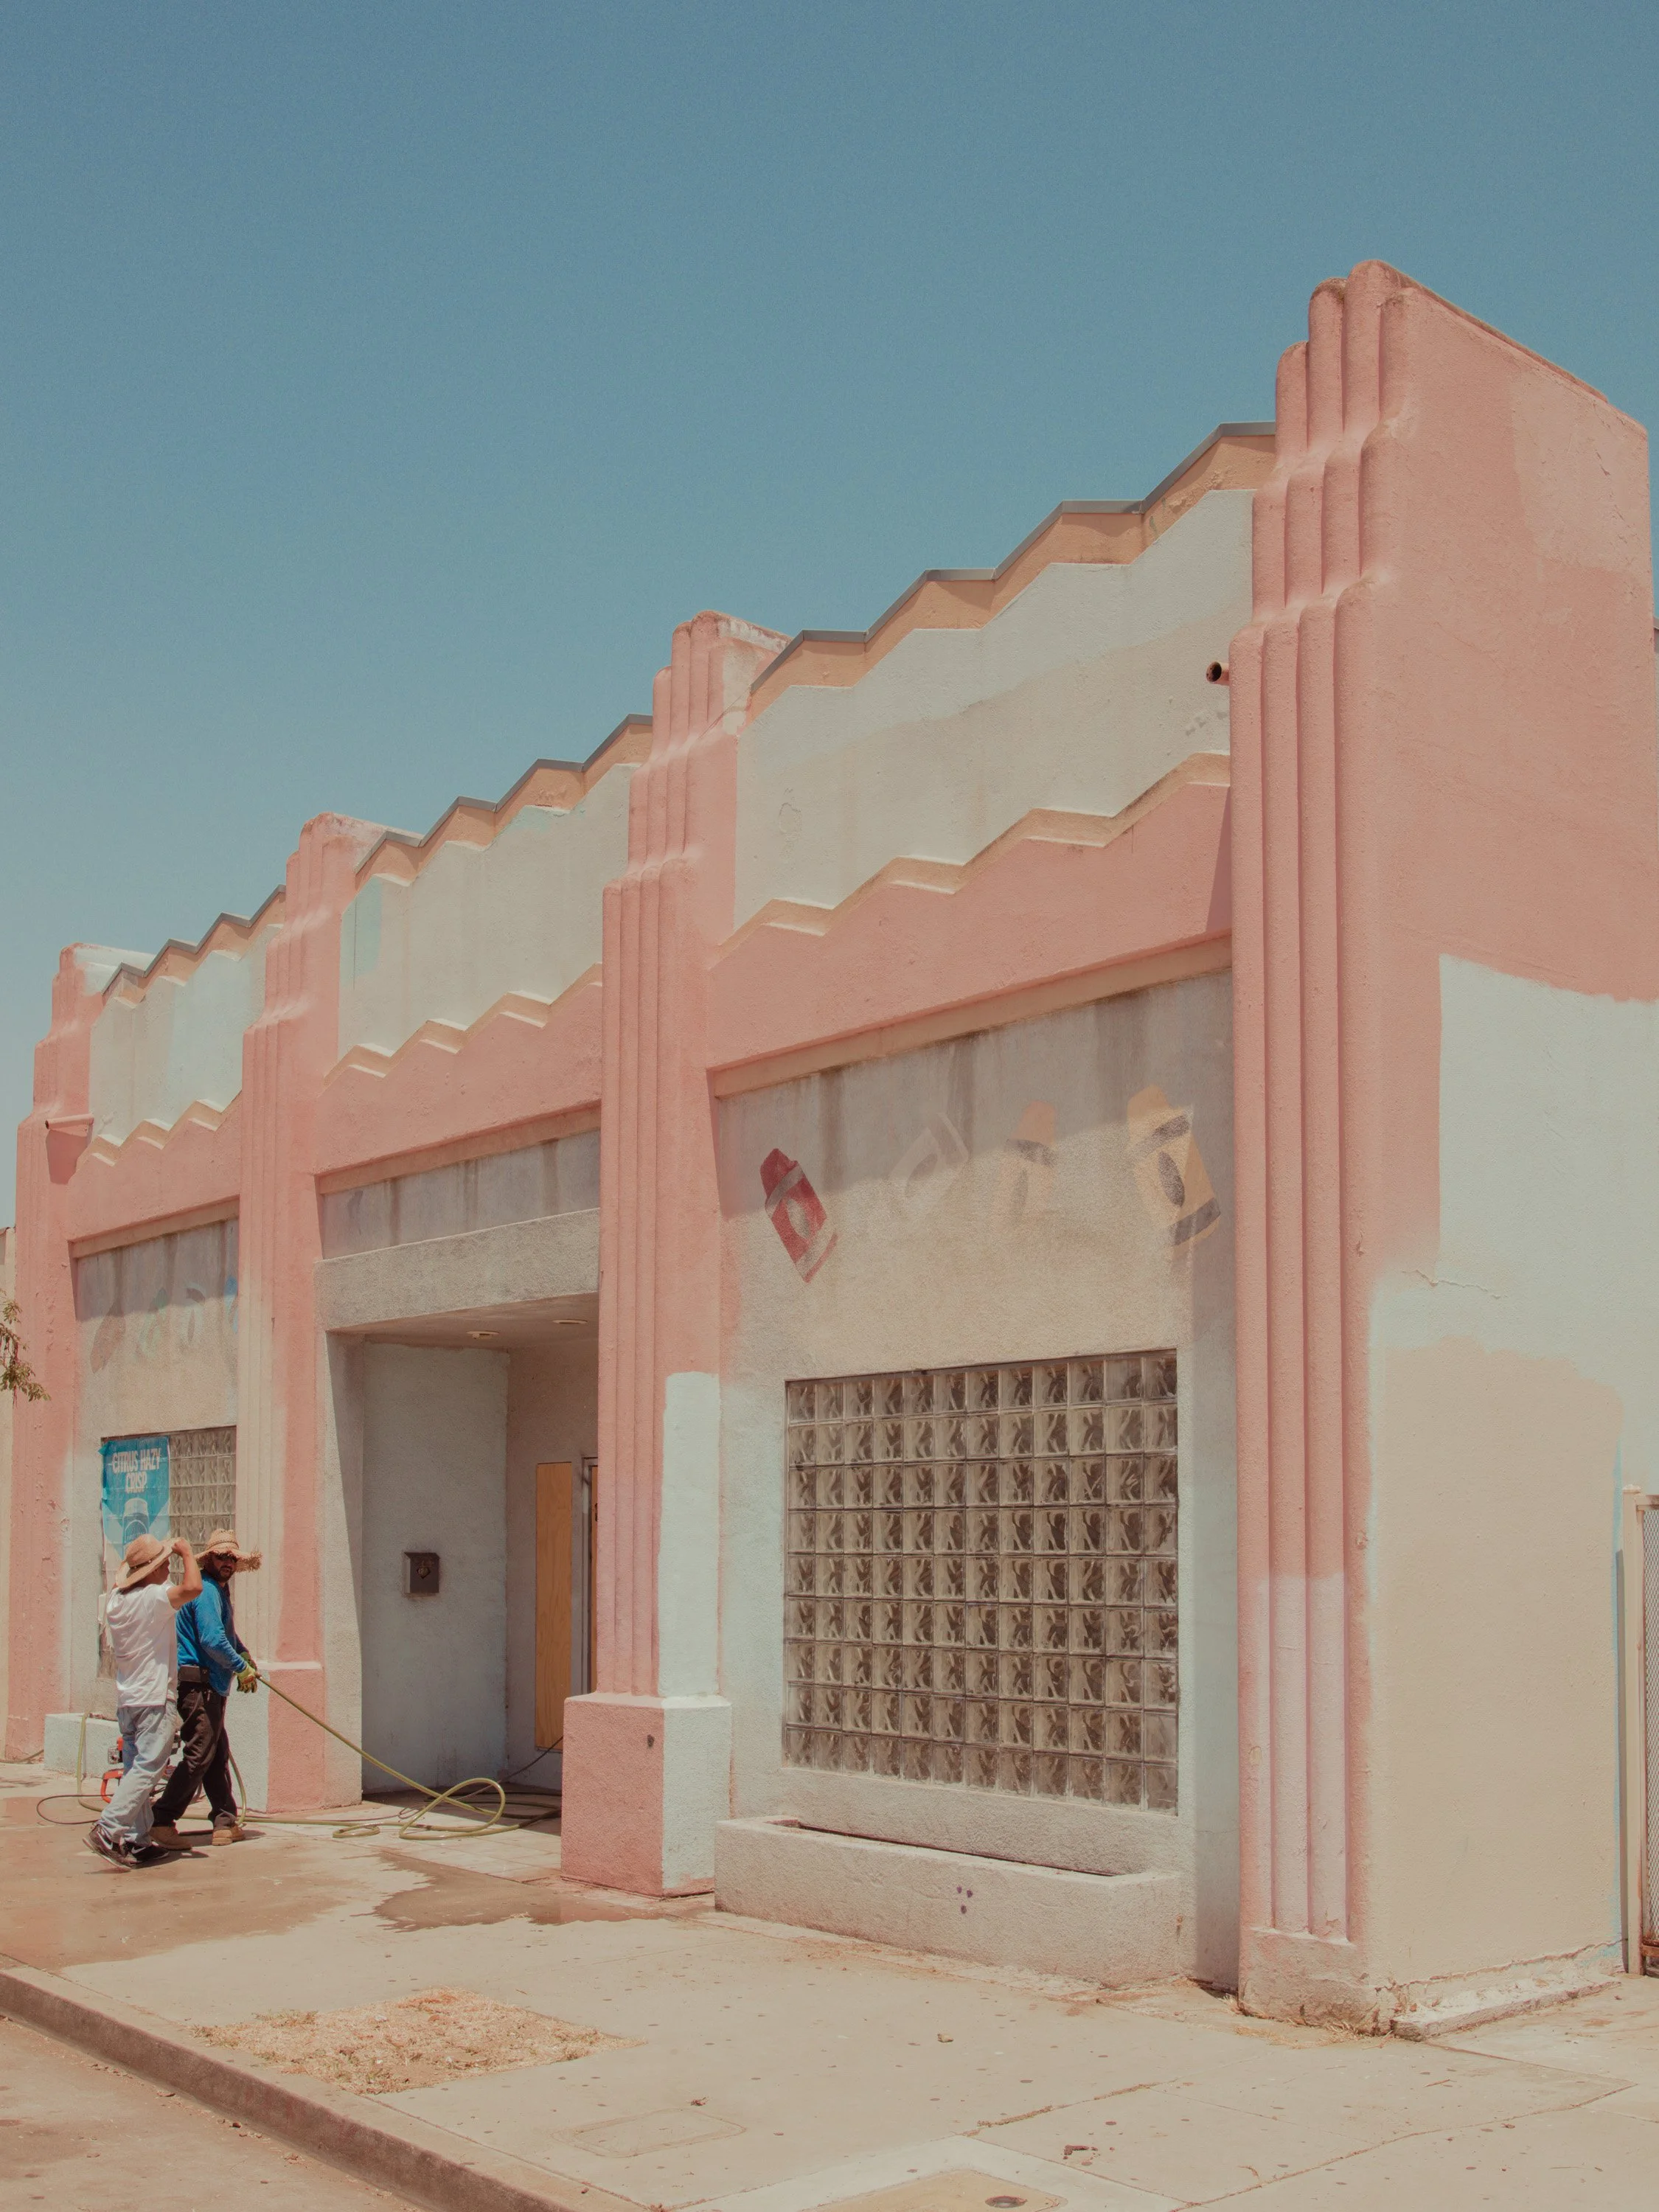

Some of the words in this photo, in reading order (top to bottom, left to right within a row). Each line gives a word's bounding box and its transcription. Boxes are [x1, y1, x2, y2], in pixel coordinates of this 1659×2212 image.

[112, 1450, 138, 1474] CITRUS
[141, 1448, 161, 1471] HAZY
[126, 1472, 147, 1493] CRISP
